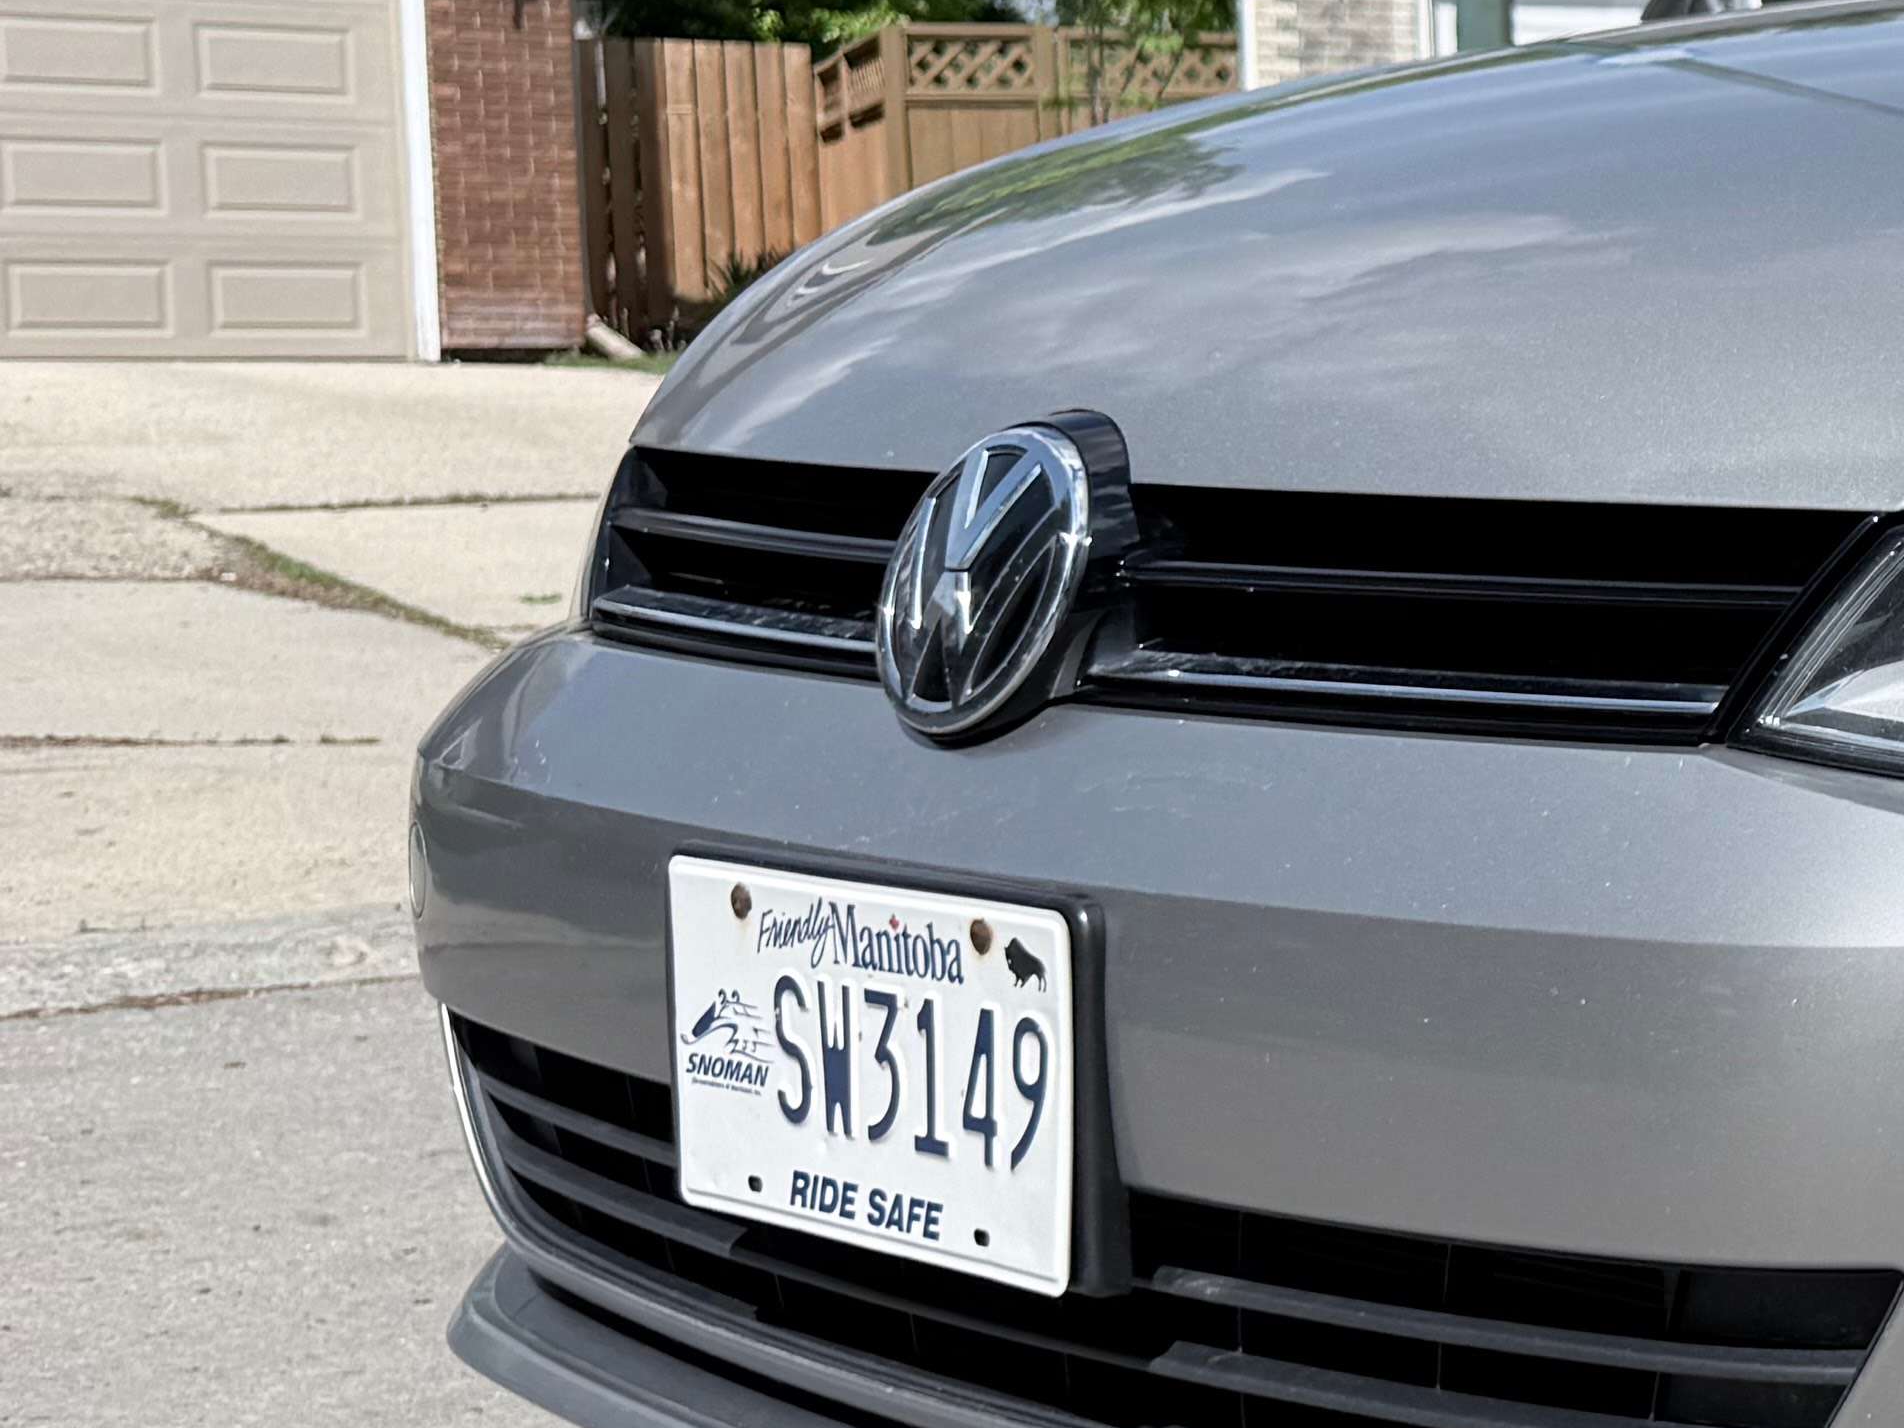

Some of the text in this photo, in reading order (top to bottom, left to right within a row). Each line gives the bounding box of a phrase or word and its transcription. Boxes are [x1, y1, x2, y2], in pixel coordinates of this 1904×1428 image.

[756, 896, 964, 985] Friendly Manitoba
[686, 1053, 769, 1087] SNOMAN
[774, 974, 1048, 1172] SW3149
[790, 1170, 944, 1241] RIDE SAFE
